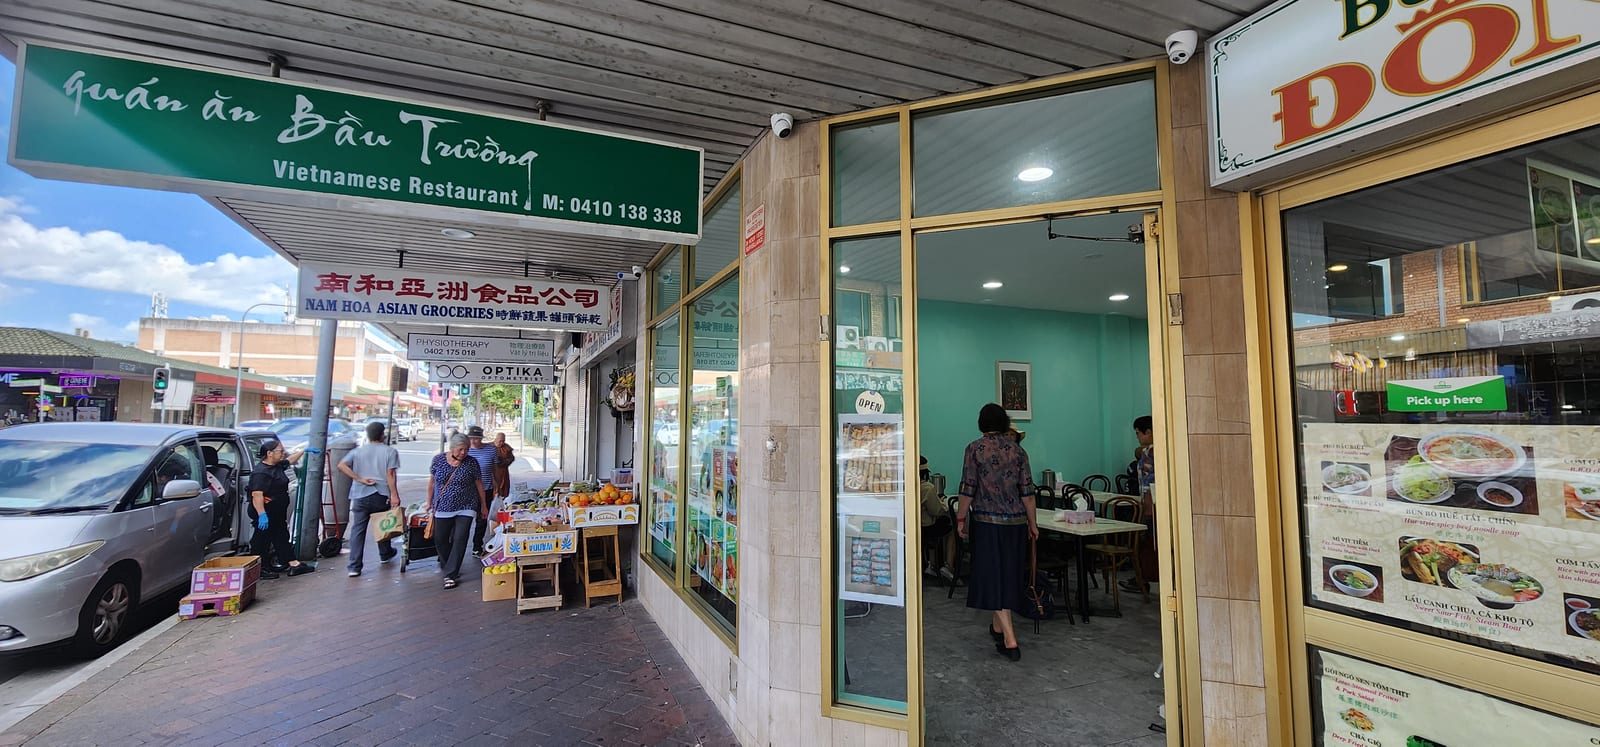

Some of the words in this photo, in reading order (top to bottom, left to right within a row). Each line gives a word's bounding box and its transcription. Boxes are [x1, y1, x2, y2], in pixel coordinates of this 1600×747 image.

[62, 70, 190, 117] quán
[201, 89, 262, 122] ăn
[277, 94, 392, 147] Bầu
[398, 110, 539, 211] Trường
[273, 159, 401, 192] Vietnamese
[409, 175, 518, 206] Restaurant
[542, 193, 564, 211] M:
[570, 197, 612, 217] 0410
[618, 203, 648, 221] 138
[653, 207, 682, 225] 338
[313, 272, 599, 309] 南和亞洲食品公司
[305, 298, 337, 312] NAM
[341, 300, 372, 314] HOA
[376, 302, 418, 316] ASIAN
[420, 304, 494, 319] GROCERIES
[416, 338, 490, 349] PHYSIOTHERAPY
[483, 366, 543, 377] OPTIKA
[858, 398, 882, 412] OPEN
[1406, 396, 1432, 405] Pick
[1434, 397, 1451, 407] up
[1453, 395, 1484, 404] here
[1456, 523, 1471, 532] beef
[1473, 526, 1499, 534] noodle
[1501, 529, 1520, 537] soup
[1414, 604, 1434, 614] Sweet
[1436, 608, 1453, 617] Sour
[1475, 616, 1500, 628] Steam
[1423, 599, 1449, 610] CANH
[1450, 604, 1476, 616] CHUA
[1478, 609, 1491, 619] CÁ
[1494, 613, 1517, 624] KHO
[1332, 732, 1347, 742] Deep
